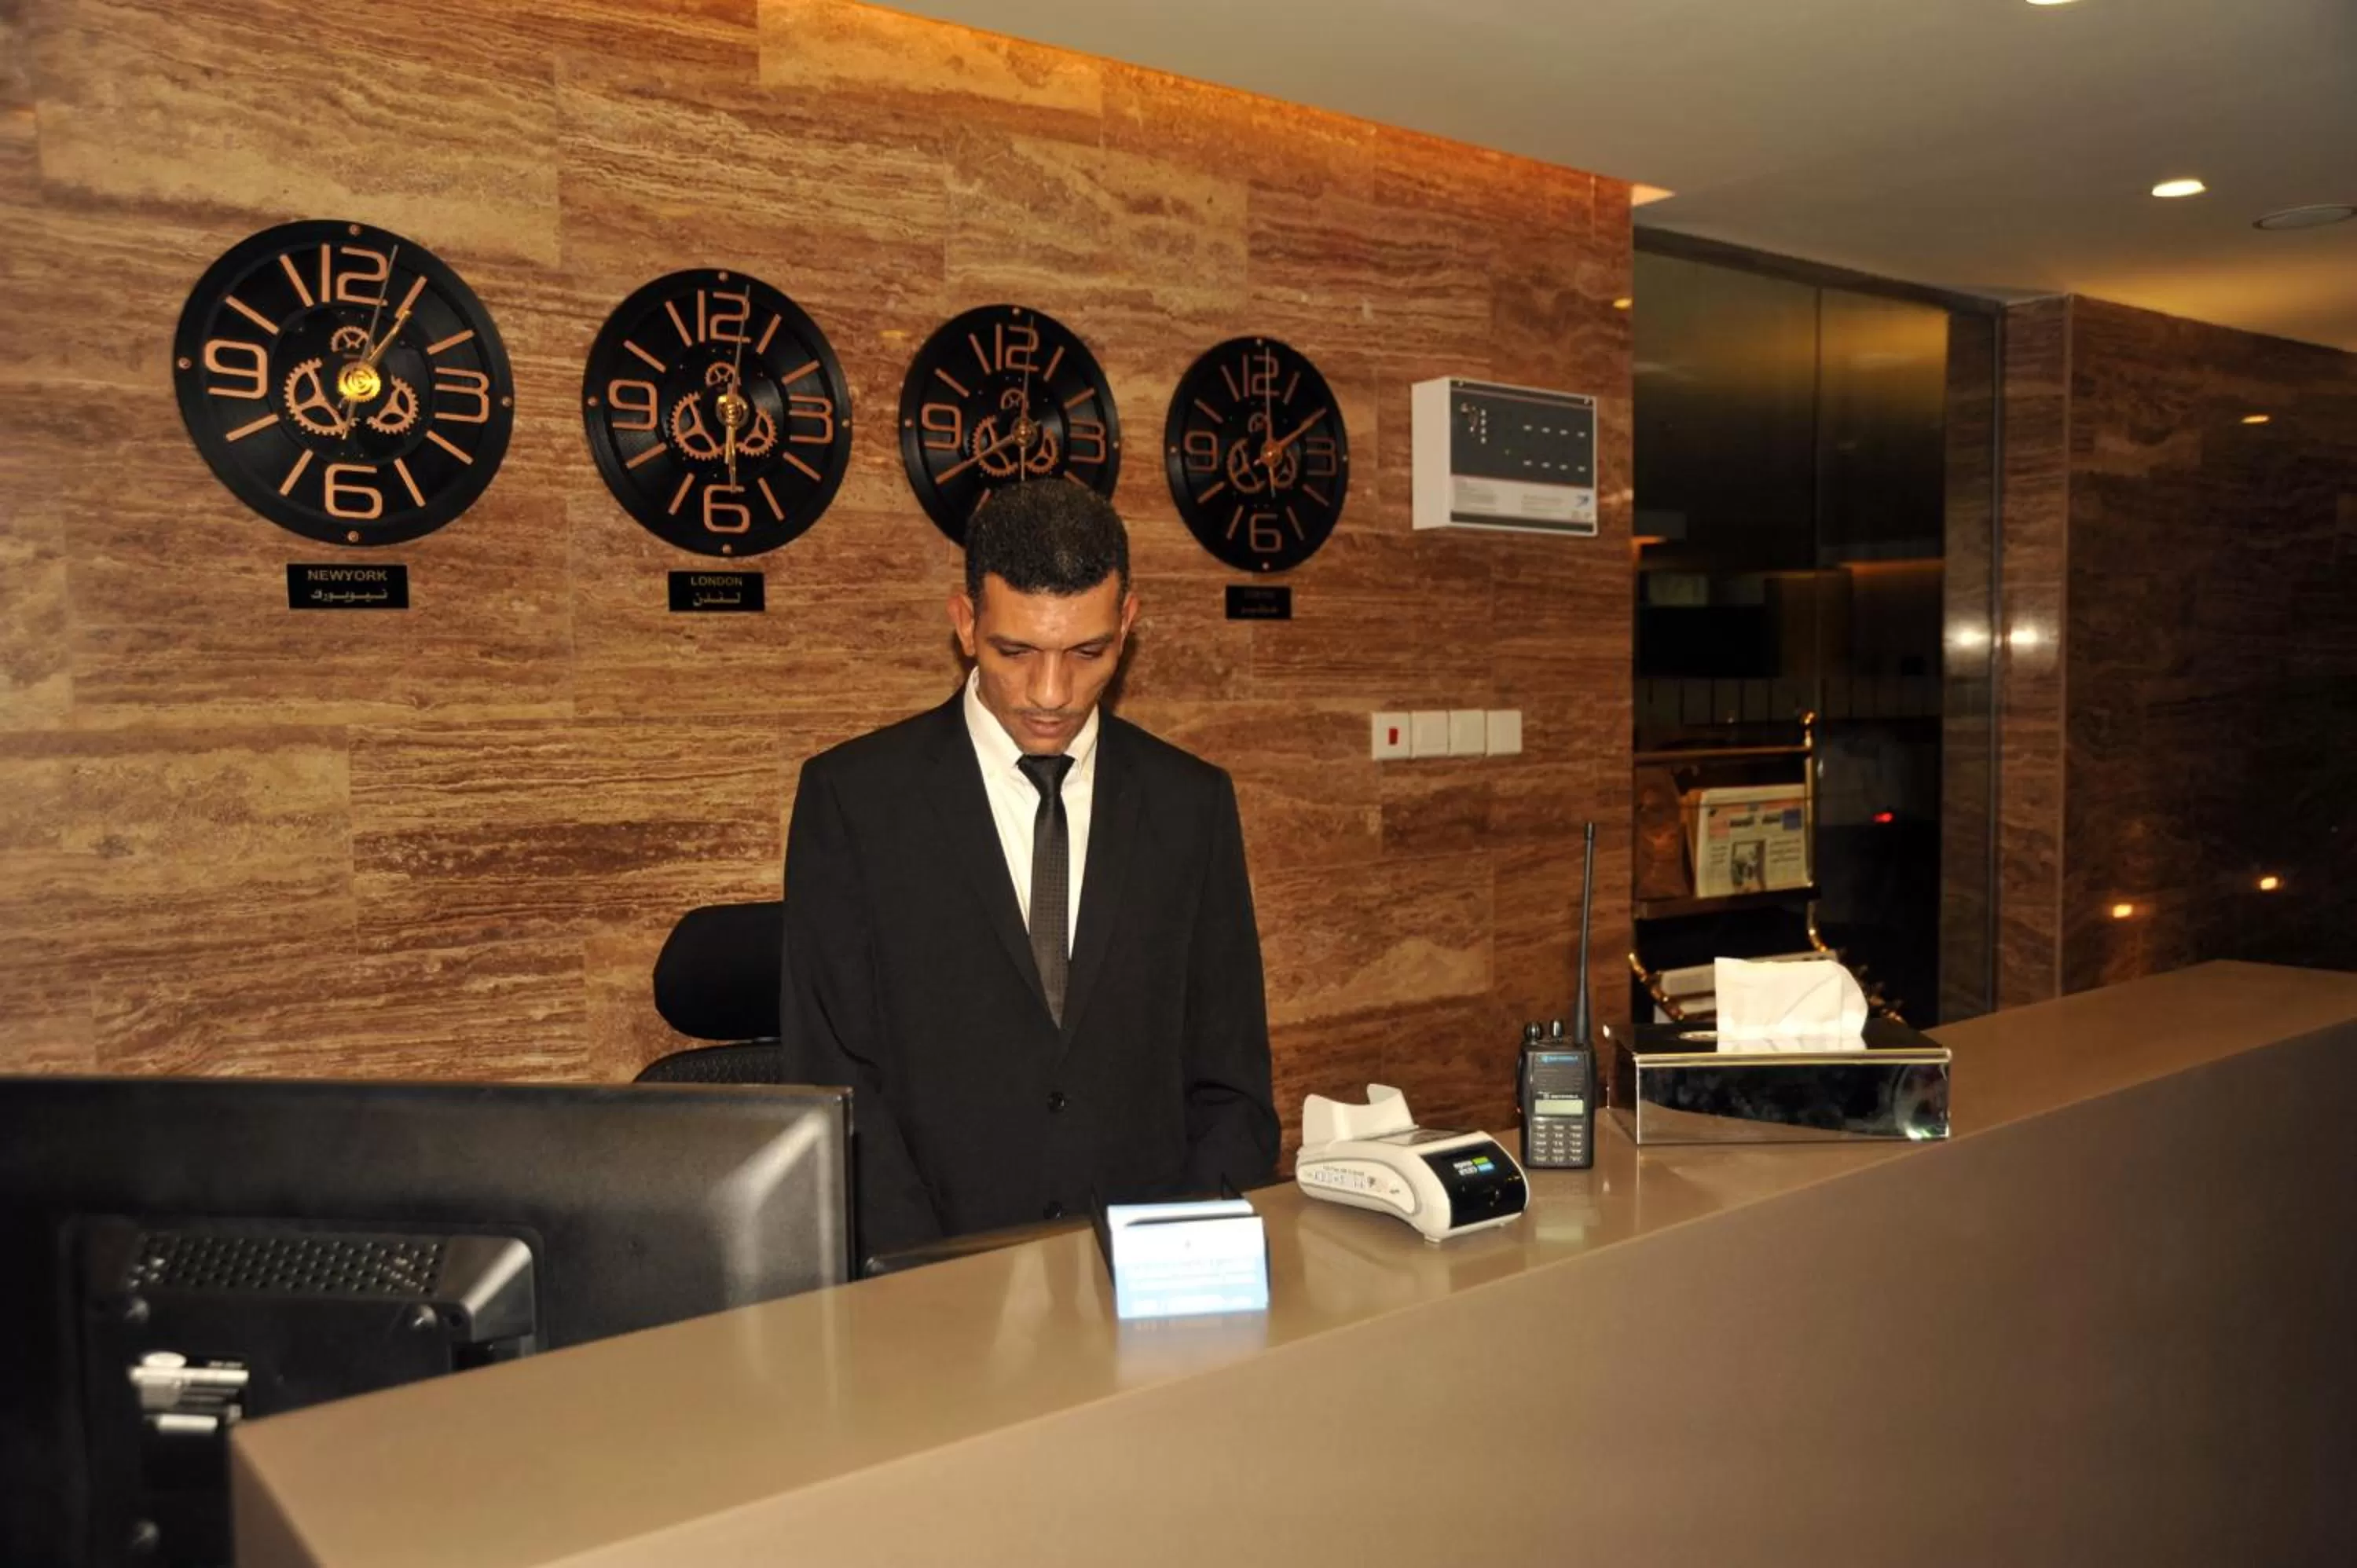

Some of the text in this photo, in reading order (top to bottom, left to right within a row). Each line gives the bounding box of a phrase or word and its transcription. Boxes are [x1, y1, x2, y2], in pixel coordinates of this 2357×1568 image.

[321, 243, 390, 307] 12
[697, 290, 752, 343] 12
[203, 339, 269, 400] 9
[995, 322, 1040, 372] 12
[434, 366, 490, 423] 3
[1241, 354, 1281, 397] 12
[607, 379, 658, 431] 9
[788, 394, 834, 445] 3
[921, 402, 962, 450] 9
[1069, 417, 1106, 464] 3
[1183, 431, 1219, 471] 9
[1305, 437, 1337, 477] 3
[324, 463, 383, 519] 6
[703, 483, 751, 533] 6
[1248, 512, 1283, 553] 6
[306, 569, 388, 581] NEWYORK
[690, 575, 743, 588] LONDON
[692, 590, 742, 607] لندن
